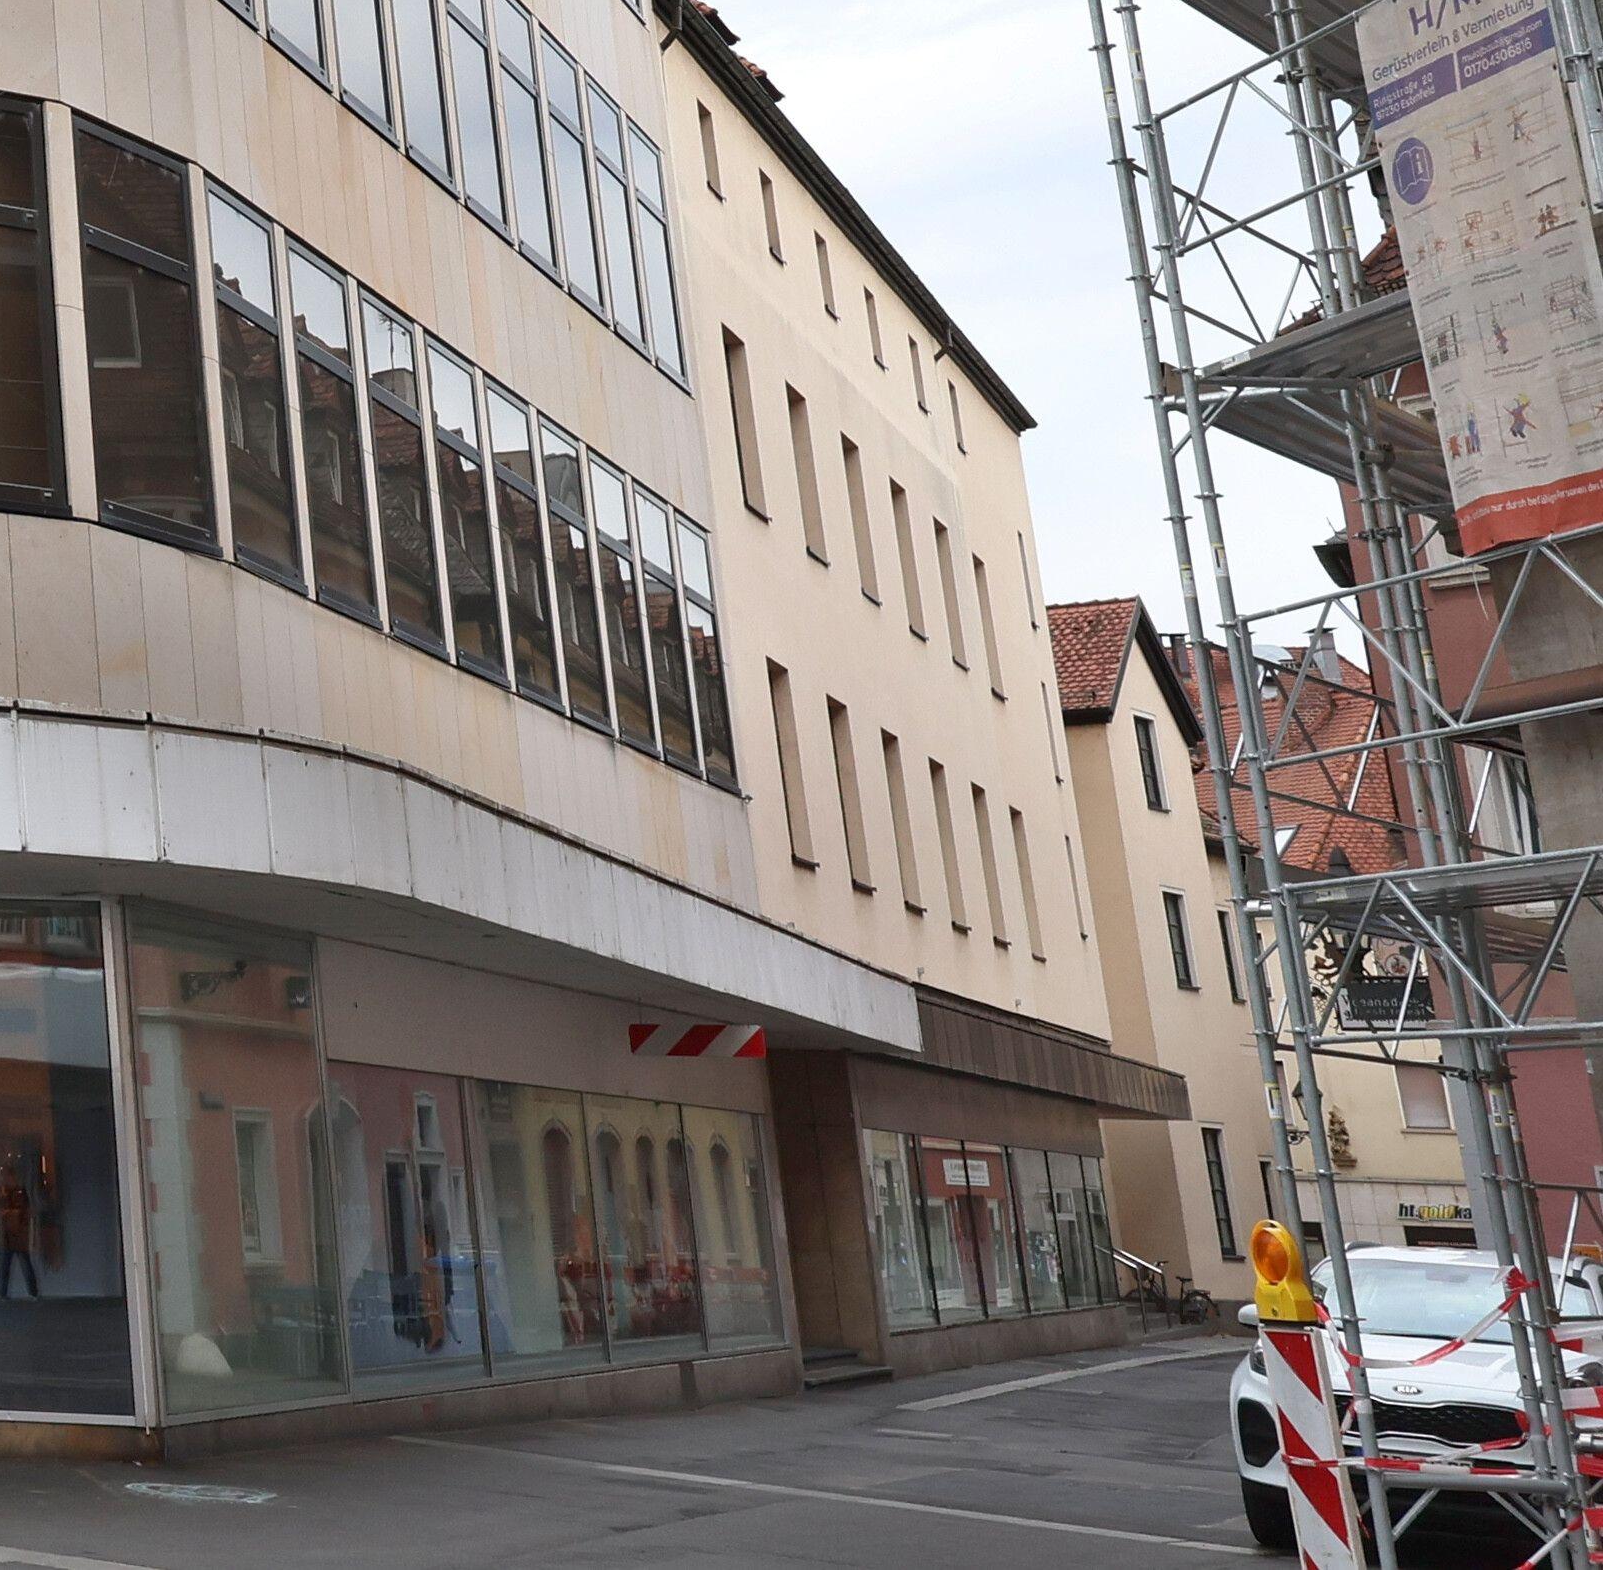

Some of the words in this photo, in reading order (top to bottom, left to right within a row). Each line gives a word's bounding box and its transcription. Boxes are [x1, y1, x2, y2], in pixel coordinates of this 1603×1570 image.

[1372, 34, 1450, 82] Gerüstverleih
[1452, 31, 1461, 44] &
[1396, 1385, 1419, 1395] KIA
